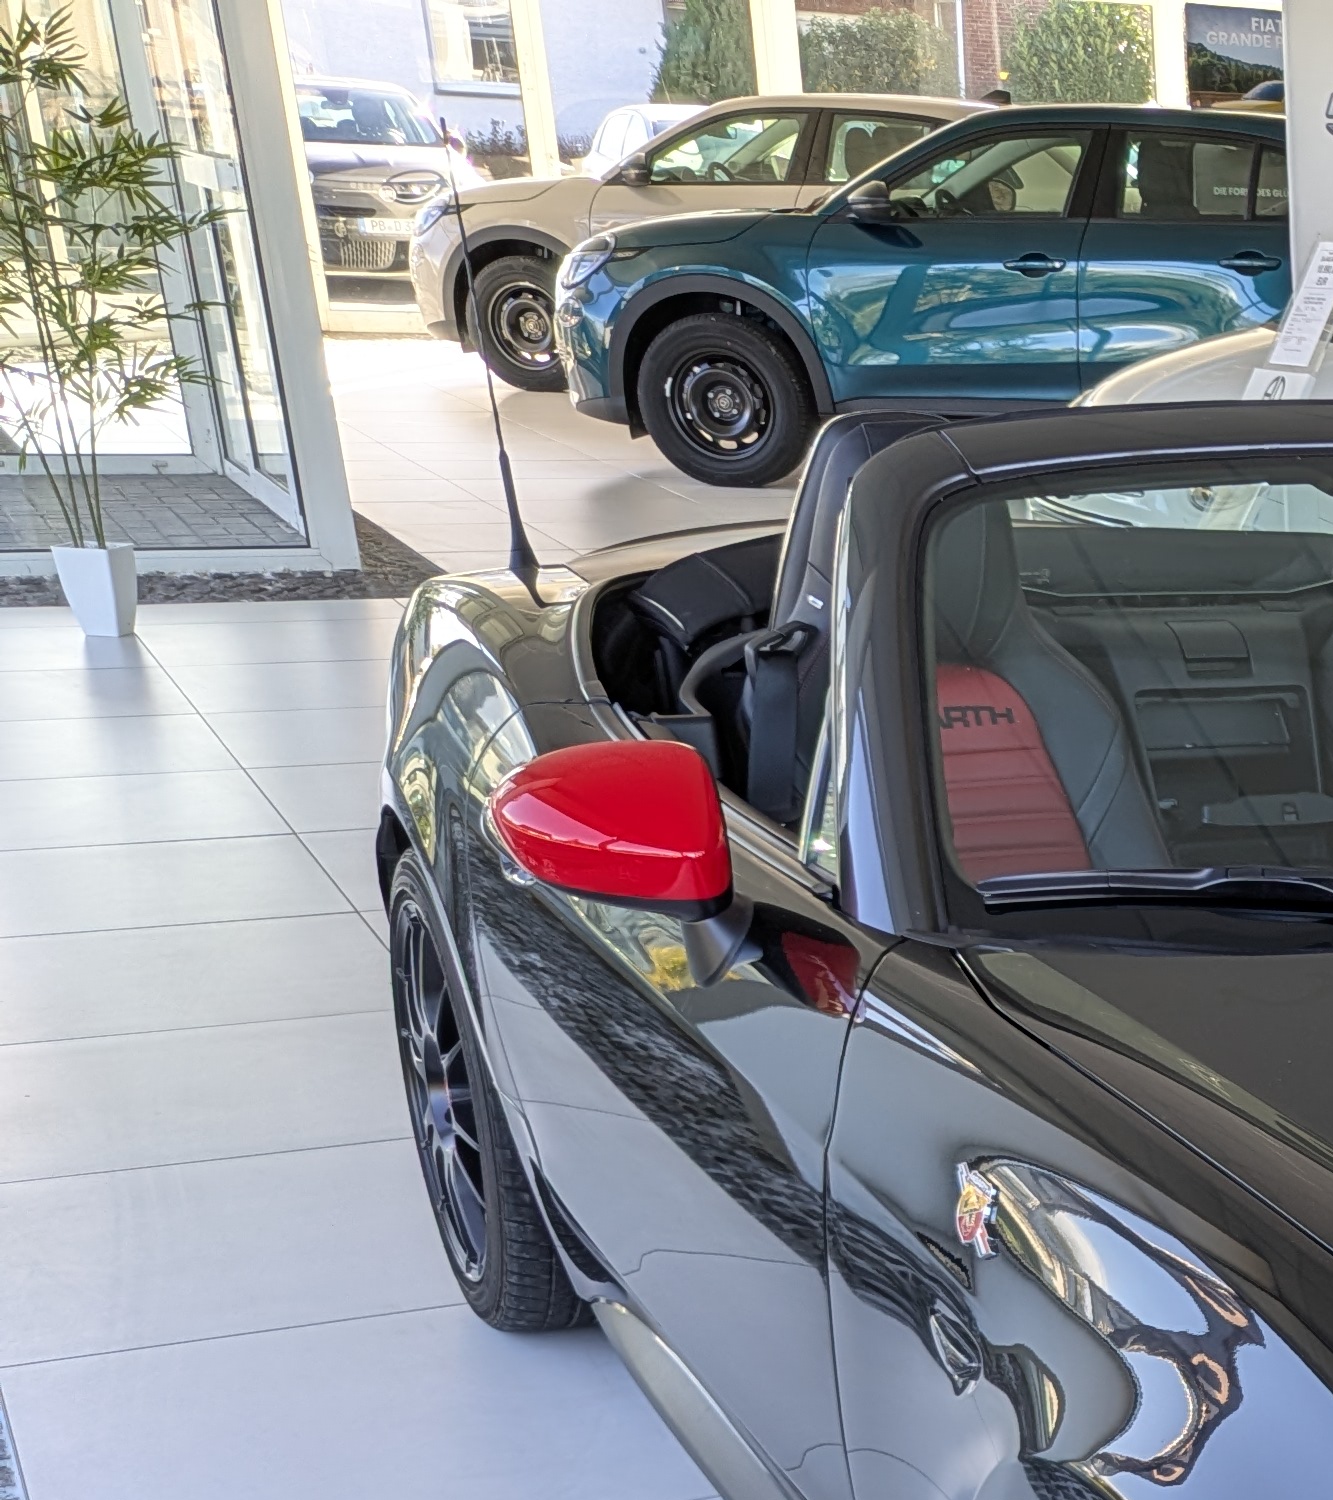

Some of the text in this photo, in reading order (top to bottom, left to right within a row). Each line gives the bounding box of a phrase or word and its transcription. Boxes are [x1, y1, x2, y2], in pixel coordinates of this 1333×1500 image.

[1251, 17, 1283, 33] FIAT
[1206, 31, 1272, 48] GRANDE
[1213, 186, 1227, 196] DIE
